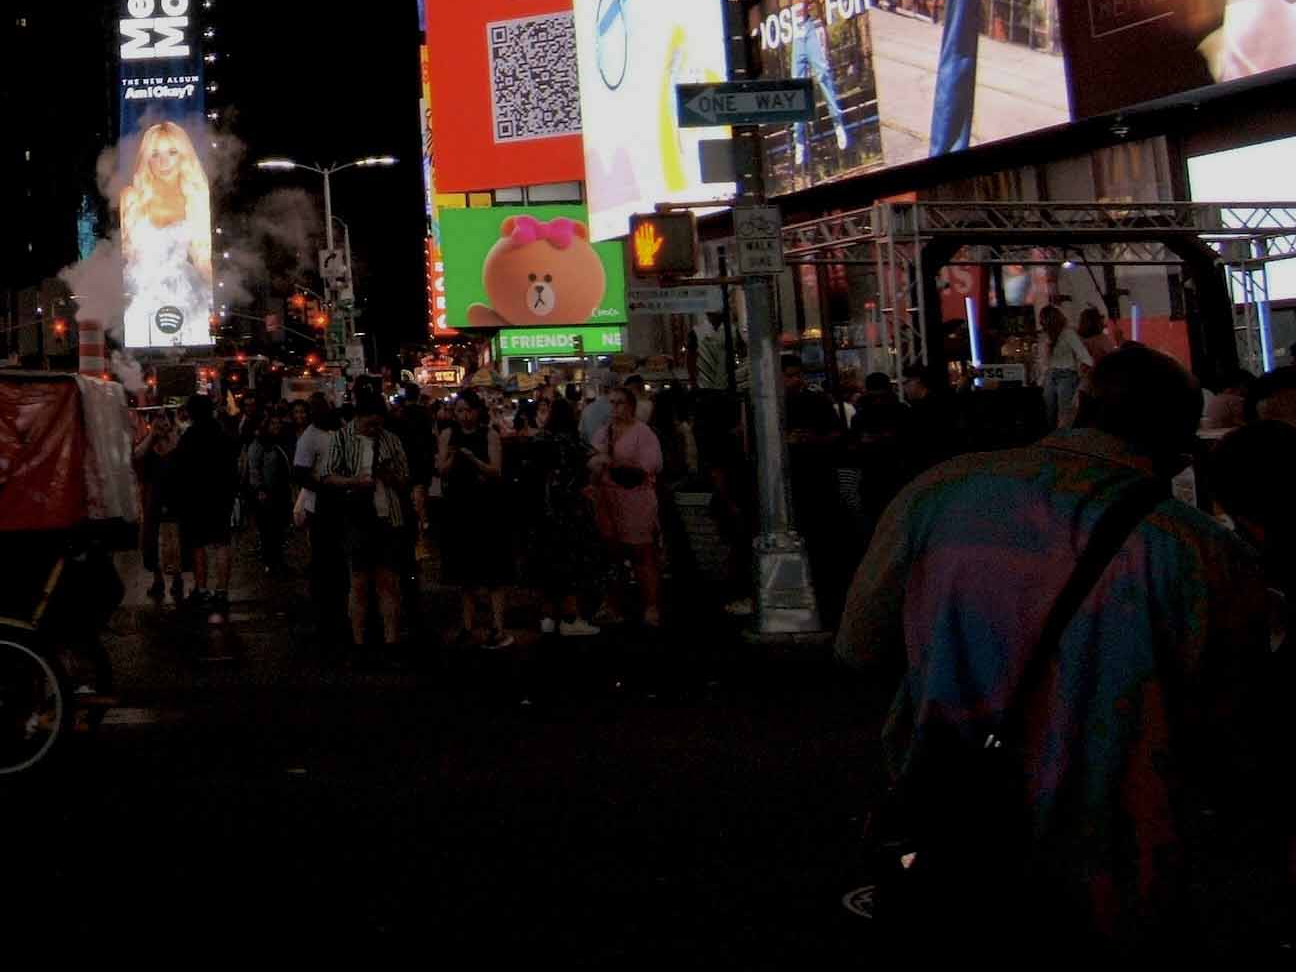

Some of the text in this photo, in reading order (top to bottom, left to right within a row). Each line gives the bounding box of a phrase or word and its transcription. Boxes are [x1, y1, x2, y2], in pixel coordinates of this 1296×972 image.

[122, 75, 200, 86] THE NEW ALBUM
[124, 85, 148, 101] Am
[153, 83, 195, 100] Okay?
[698, 91, 797, 113] ONE WAY
[510, 333, 578, 349] FRIENDS
